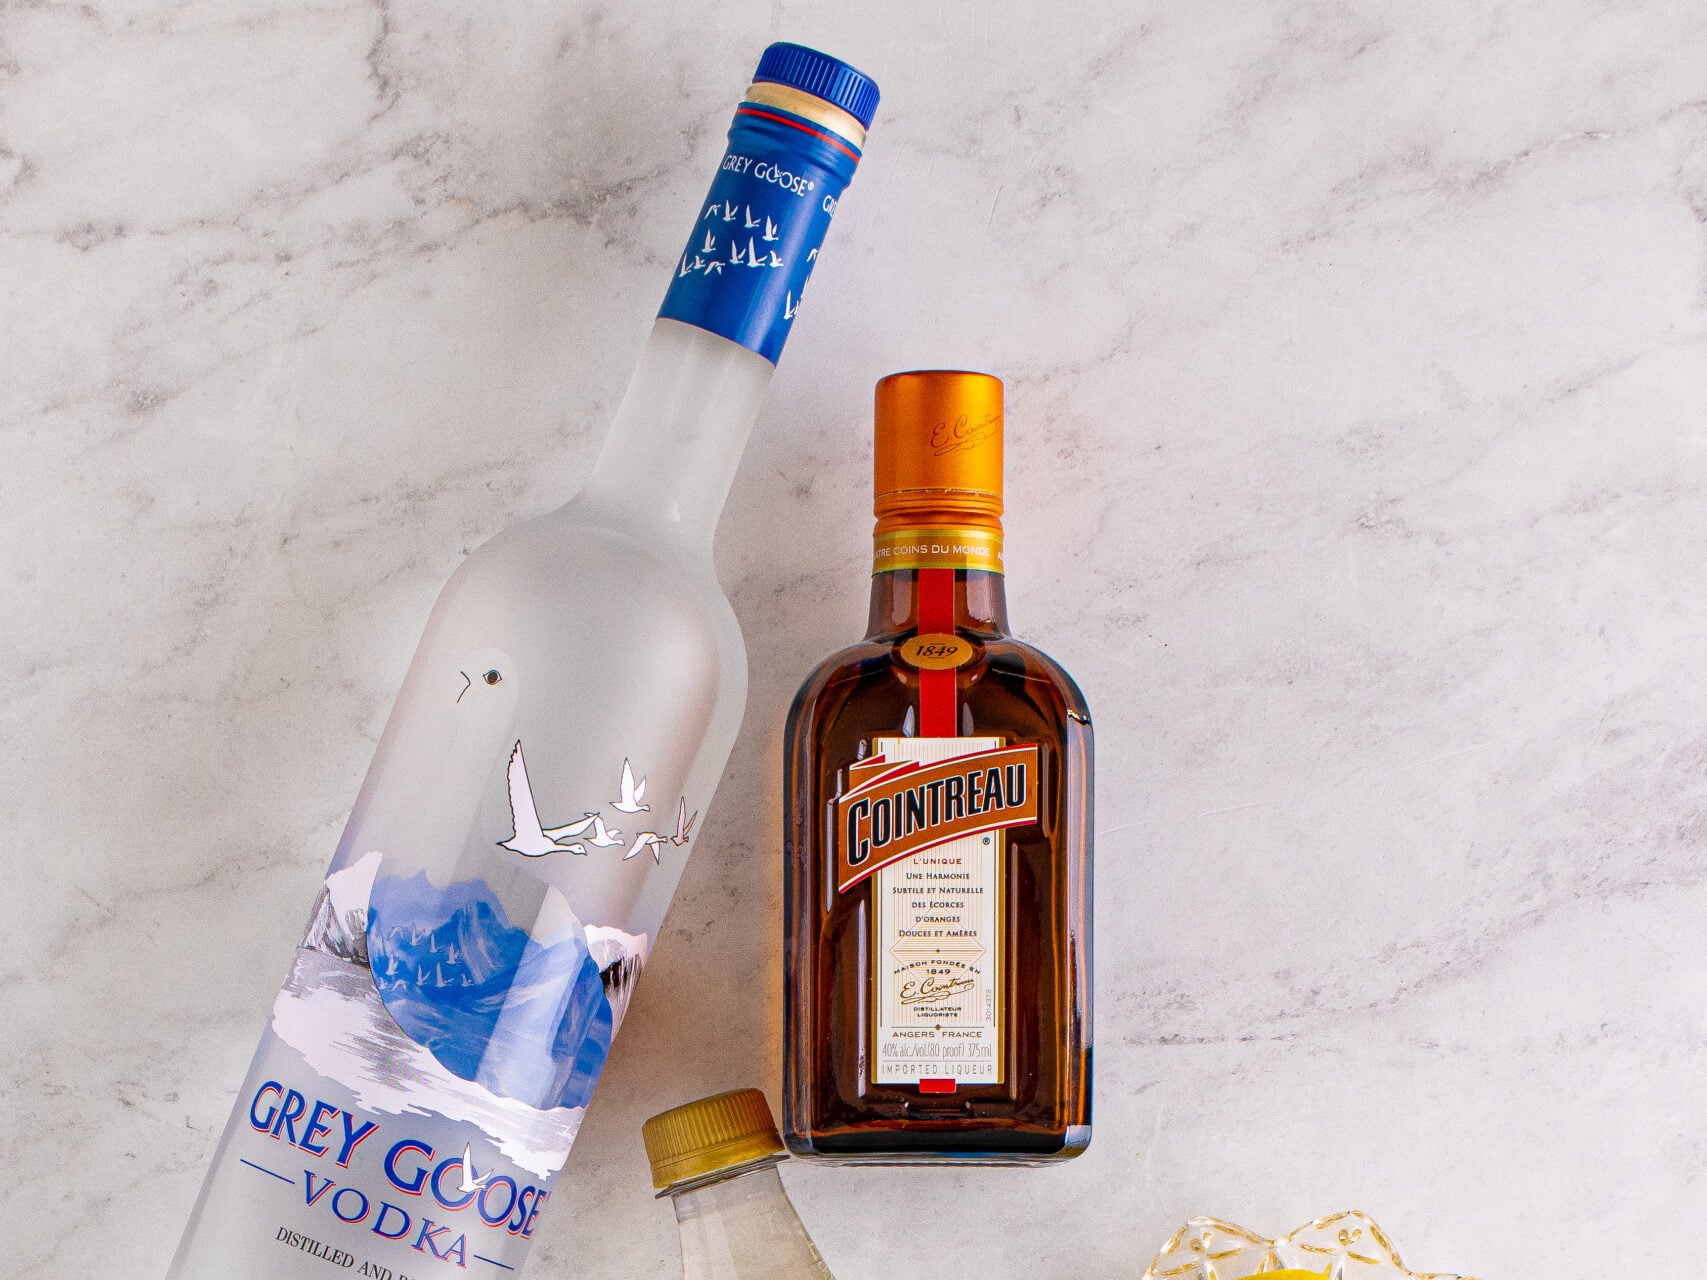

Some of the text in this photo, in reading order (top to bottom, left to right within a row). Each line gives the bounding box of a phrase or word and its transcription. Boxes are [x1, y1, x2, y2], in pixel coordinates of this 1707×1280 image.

[723, 154, 808, 197] GREY GOOSE
[893, 545, 928, 555] COINS
[931, 545, 949, 554] DU
[952, 545, 991, 557] MONDE
[915, 645, 958, 656] 1849
[847, 763, 1027, 866] COINTREAU
[915, 915, 961, 923] D'ORANGES
[894, 960, 928, 975] MAISON
[969, 966, 981, 975] EN
[882, 1042, 898, 1057] 40%
[882, 1064, 993, 1075] IMPORTED LIQUEUR
[249, 1080, 543, 1239] GREY GOOSE
[303, 1169, 468, 1268] VODKA
[275, 1227, 355, 1269] DISTILLED
